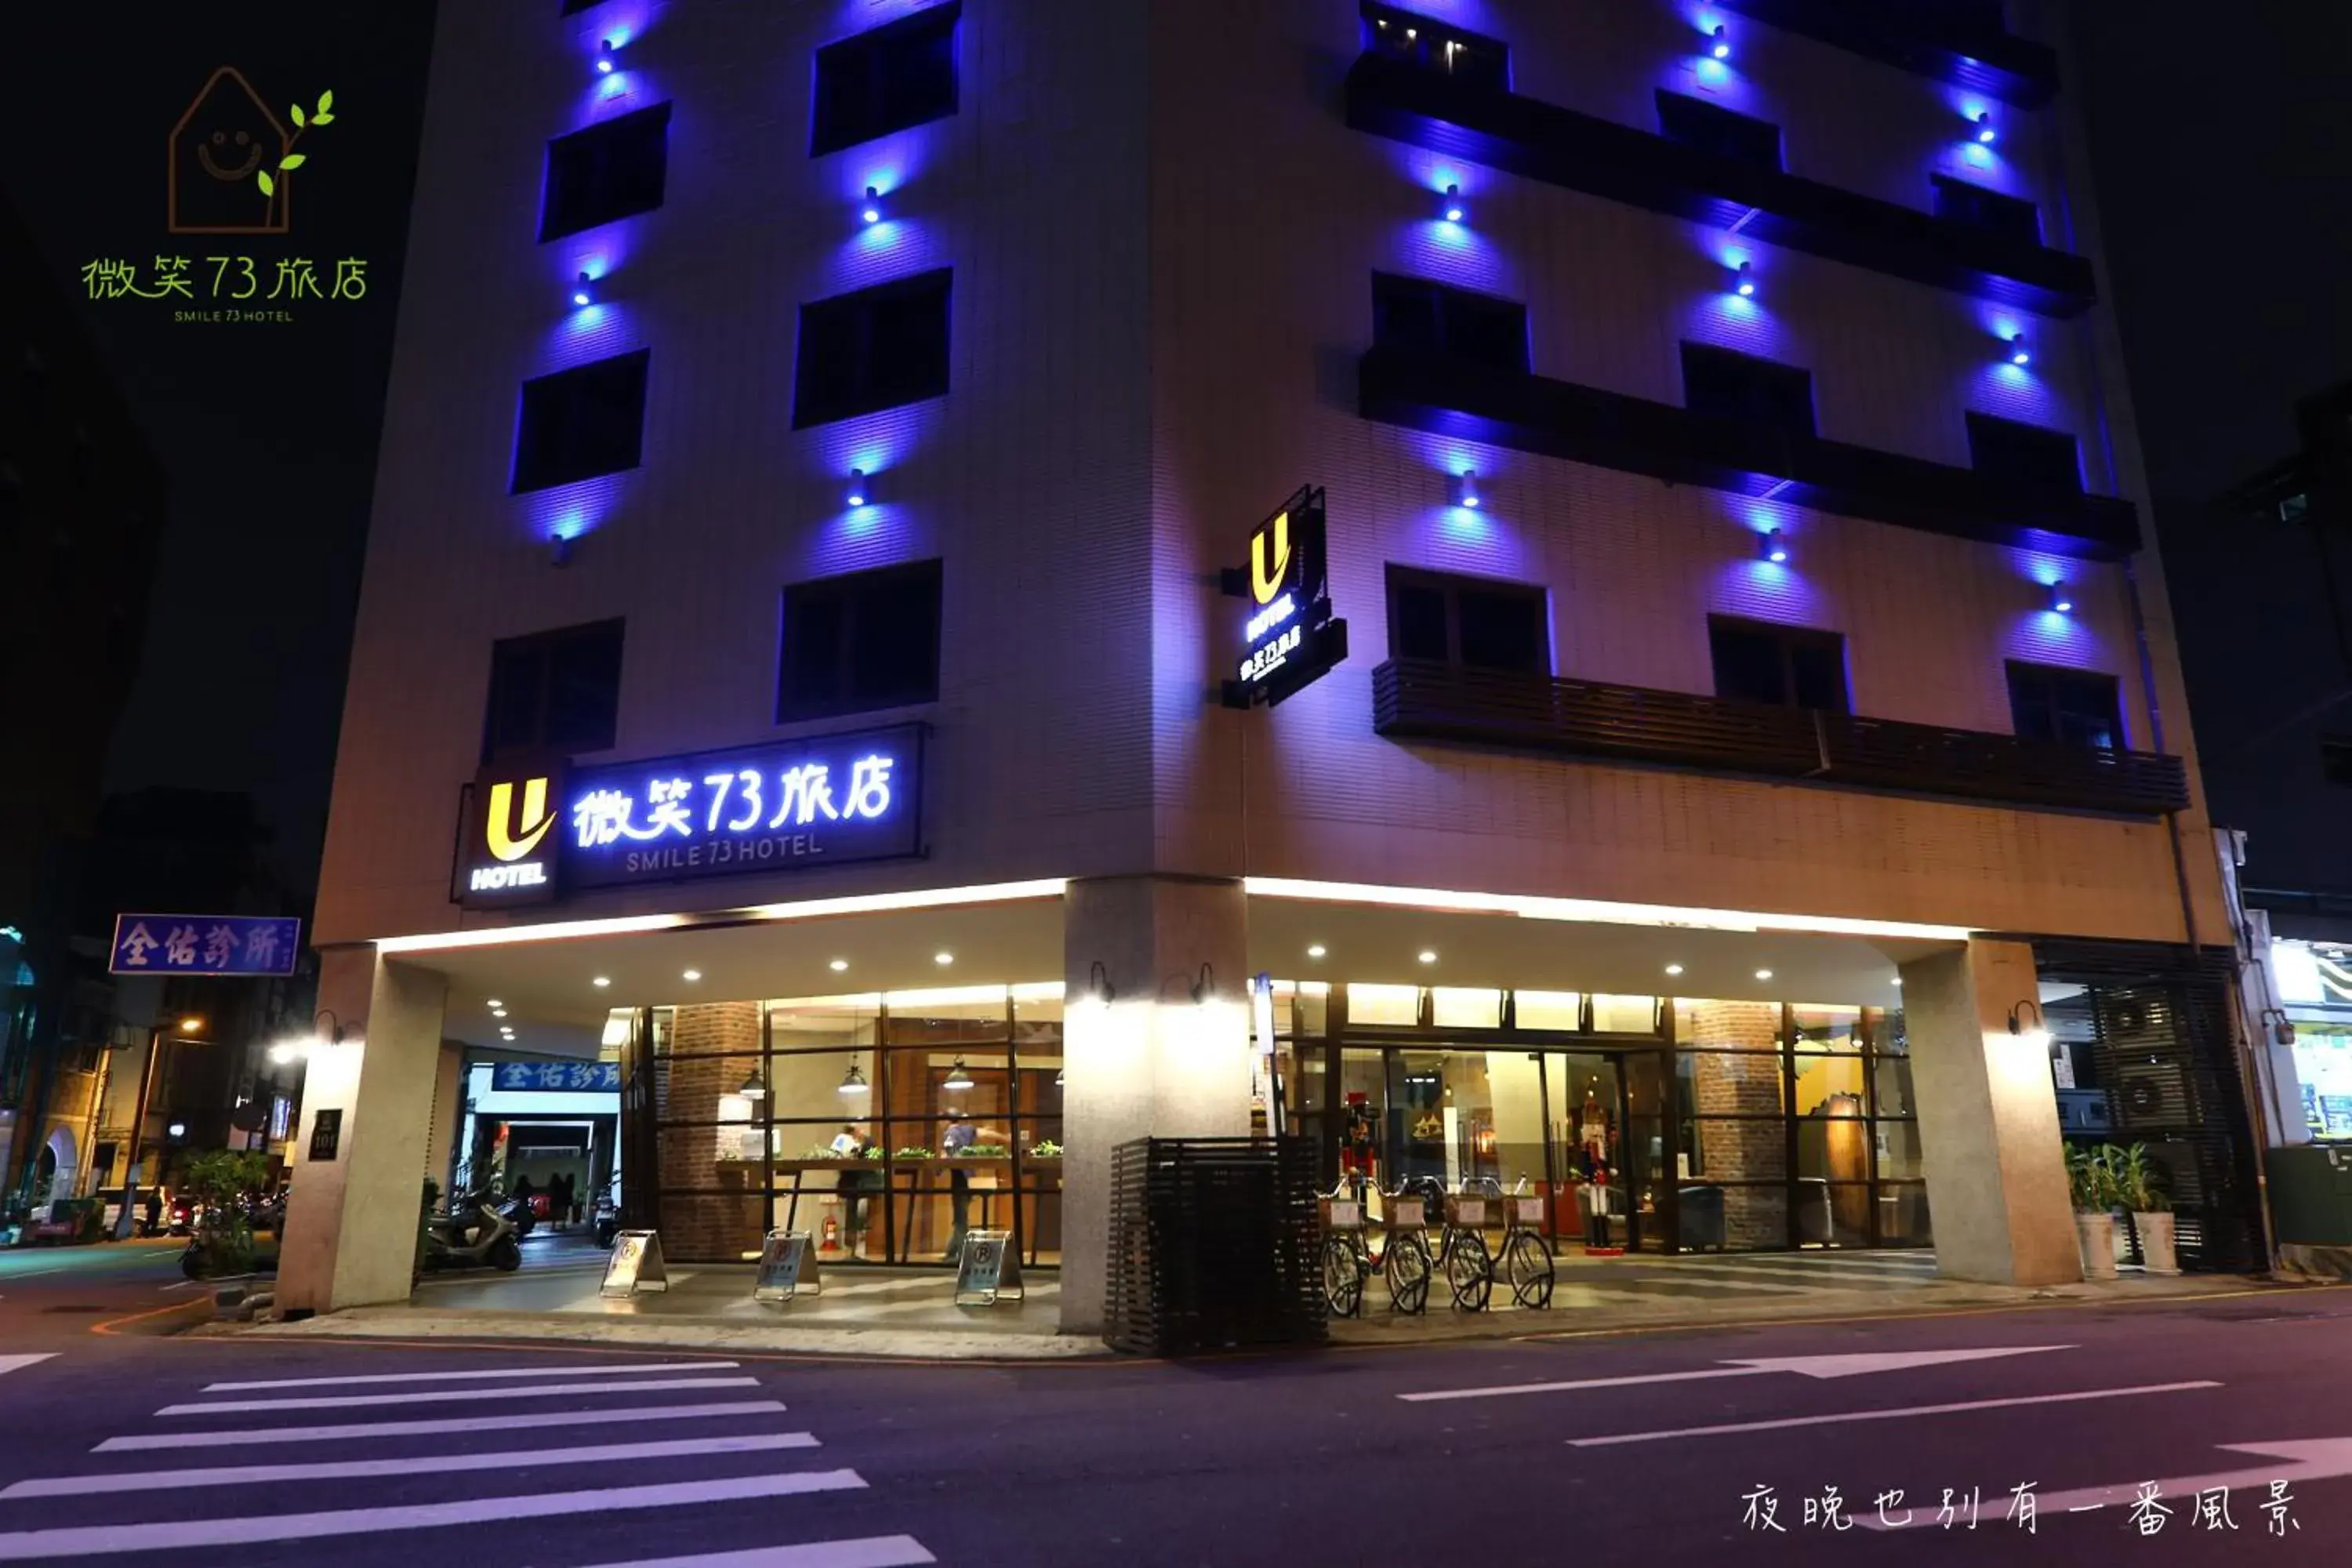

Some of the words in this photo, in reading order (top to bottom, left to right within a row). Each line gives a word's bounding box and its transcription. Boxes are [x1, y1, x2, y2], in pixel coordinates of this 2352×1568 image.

[573, 755, 894, 848] 微笑73旅店
[627, 846, 700, 873] SMILE
[708, 840, 731, 863] 73
[739, 833, 822, 861] HOTEL
[470, 863, 546, 891] HOTEL
